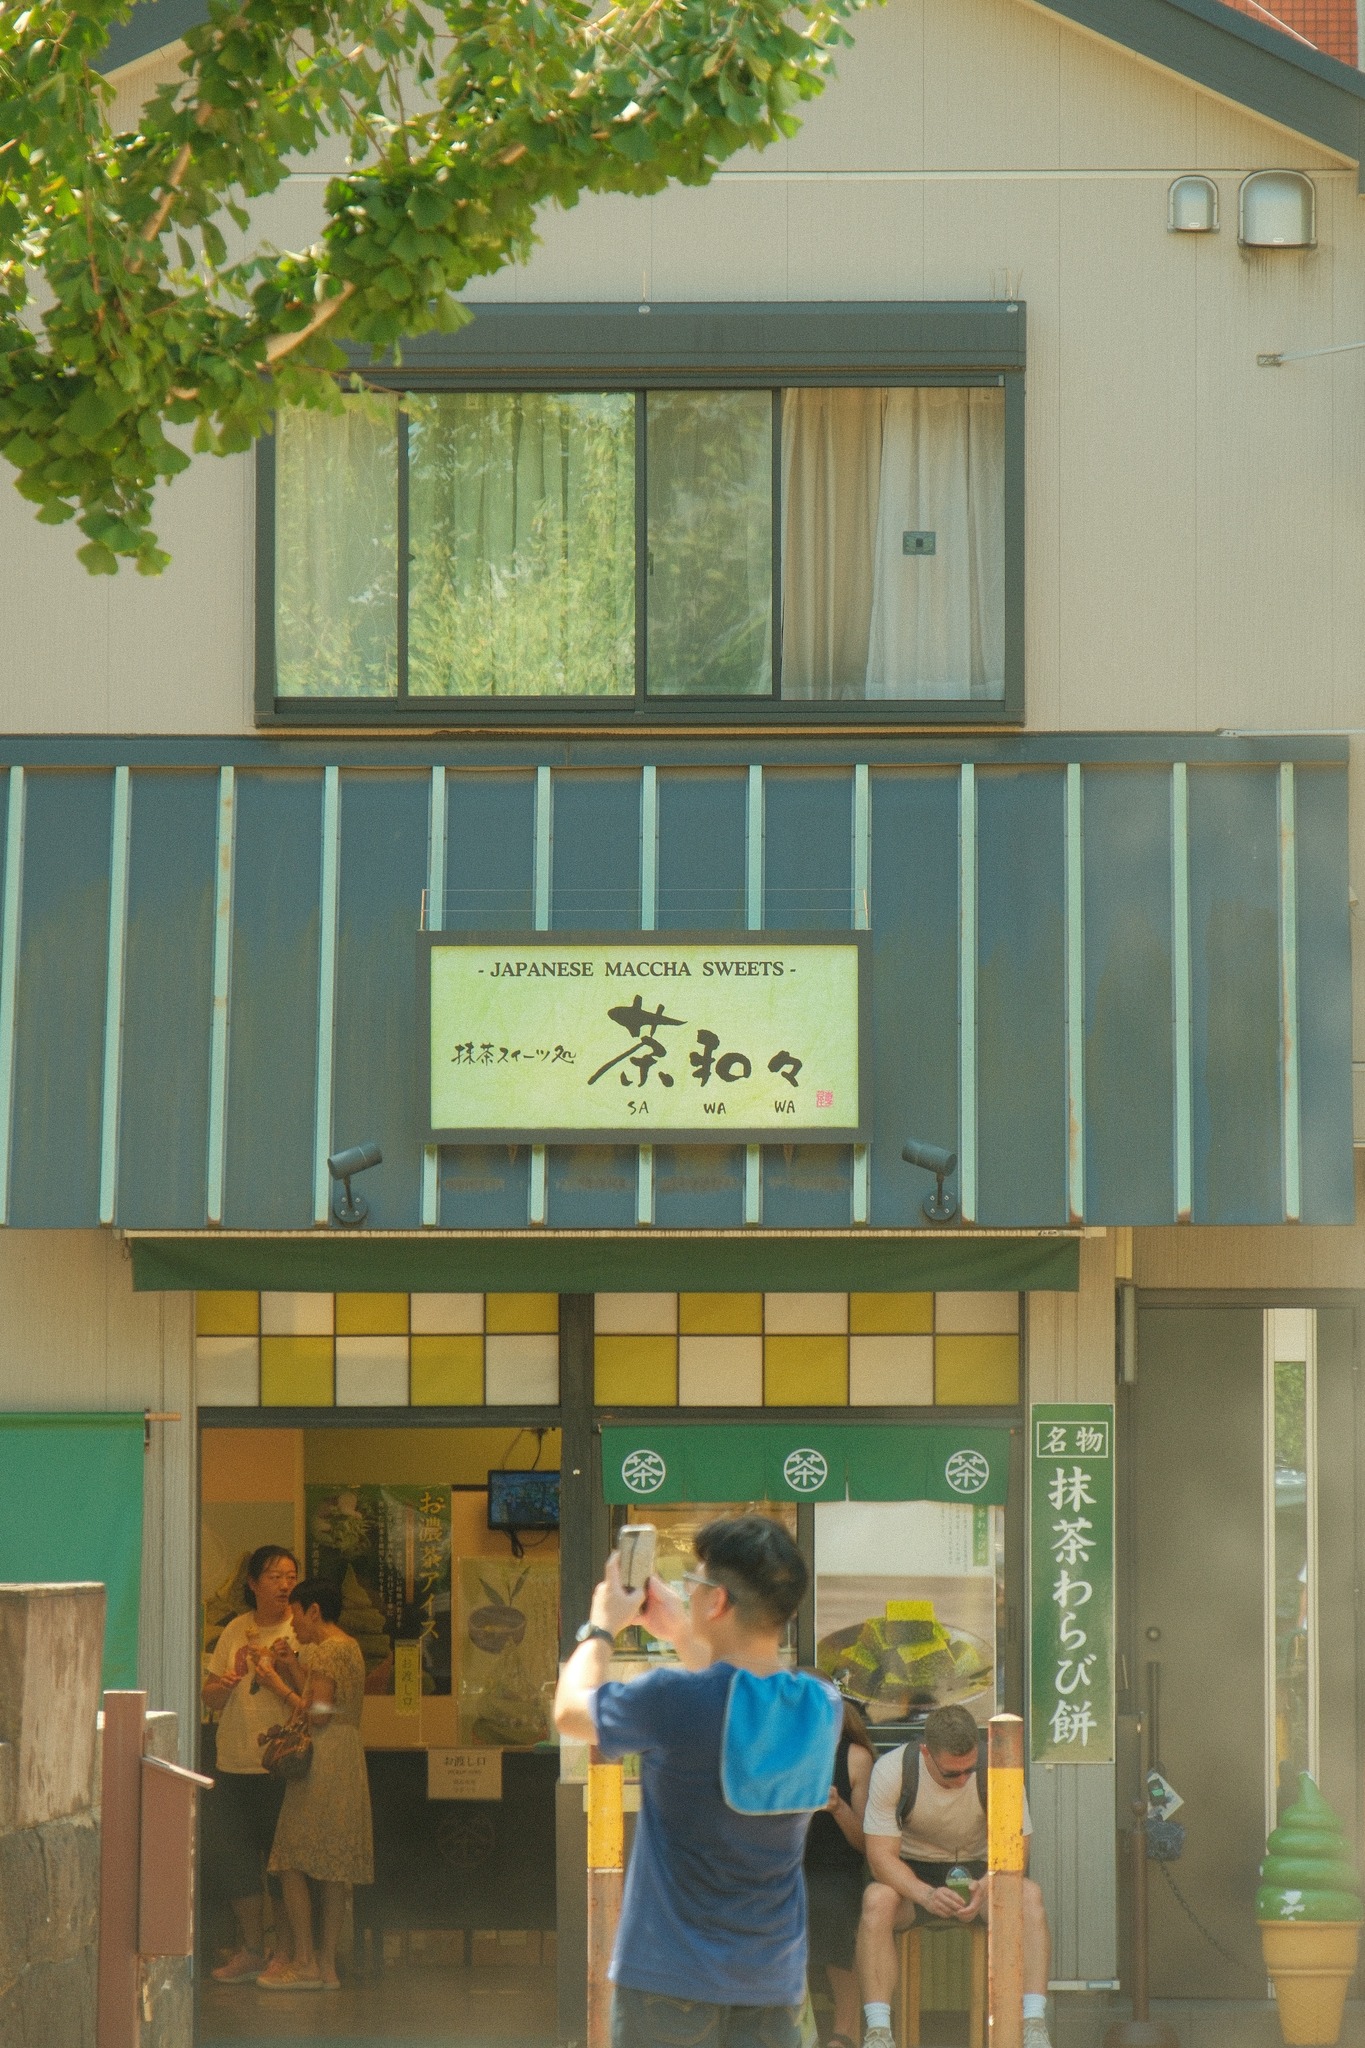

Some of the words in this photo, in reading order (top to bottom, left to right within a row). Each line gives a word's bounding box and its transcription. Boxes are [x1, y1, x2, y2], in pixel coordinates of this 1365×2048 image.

[490, 961, 594, 978] JAPANESE
[605, 961, 692, 977] MACCHA
[702, 961, 785, 977] SWEETS
[587, 994, 803, 1088] 茶和々
[627, 1100, 650, 1116] SA
[703, 1102, 727, 1115] WA
[774, 1100, 796, 1114] WA
[1042, 1425, 1104, 1454] 名物
[623, 1453, 664, 1490] 茶
[785, 1452, 826, 1489] 茶
[946, 1453, 988, 1490] 茶
[419, 1491, 446, 1640] お濃茶アイス
[1047, 1465, 1098, 1748] 抹茶わらび餅
